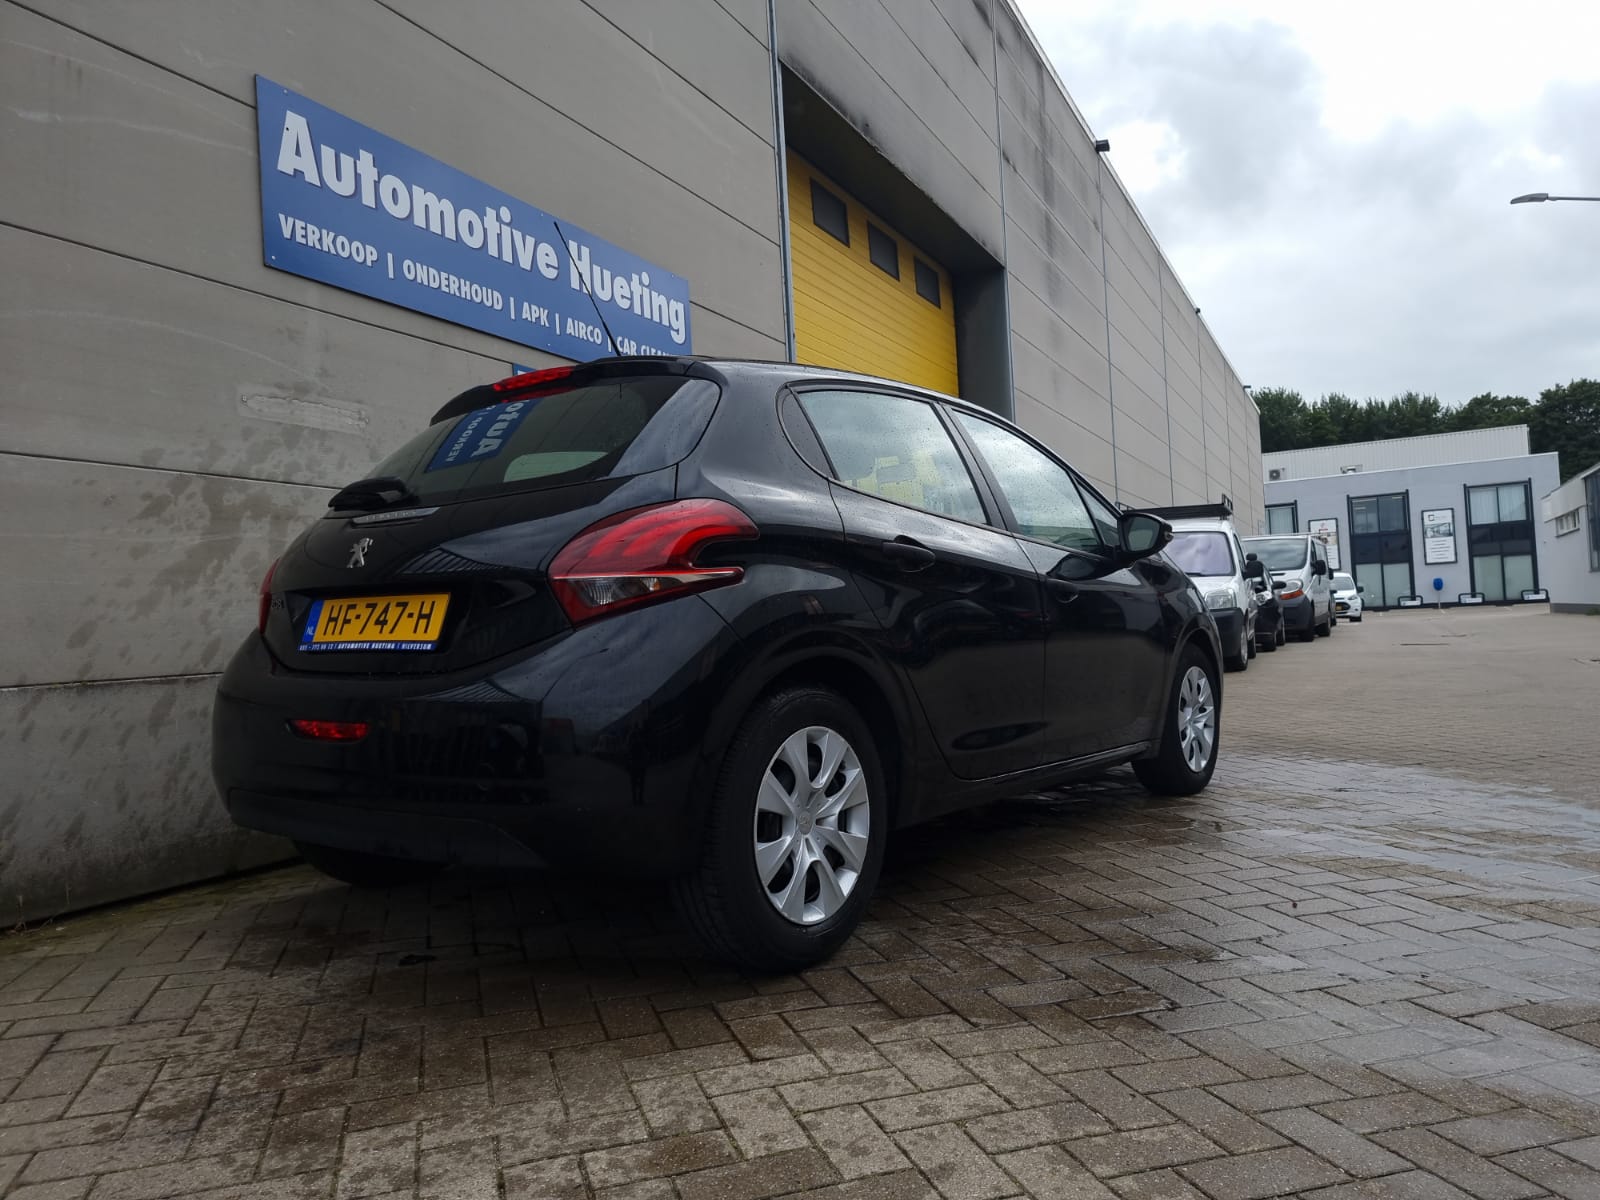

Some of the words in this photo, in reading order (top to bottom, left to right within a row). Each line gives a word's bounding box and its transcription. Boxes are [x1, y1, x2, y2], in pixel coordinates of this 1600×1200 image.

[277, 110, 560, 280] Automotive
[568, 239, 686, 345] Hueting
[278, 212, 379, 268] VERKOOP
[402, 258, 504, 311] ONDERHOUD
[521, 301, 550, 328] APK
[565, 317, 603, 345] AIRCO
[616, 335, 638, 356] CAR
[323, 600, 436, 636] HF-747-H
